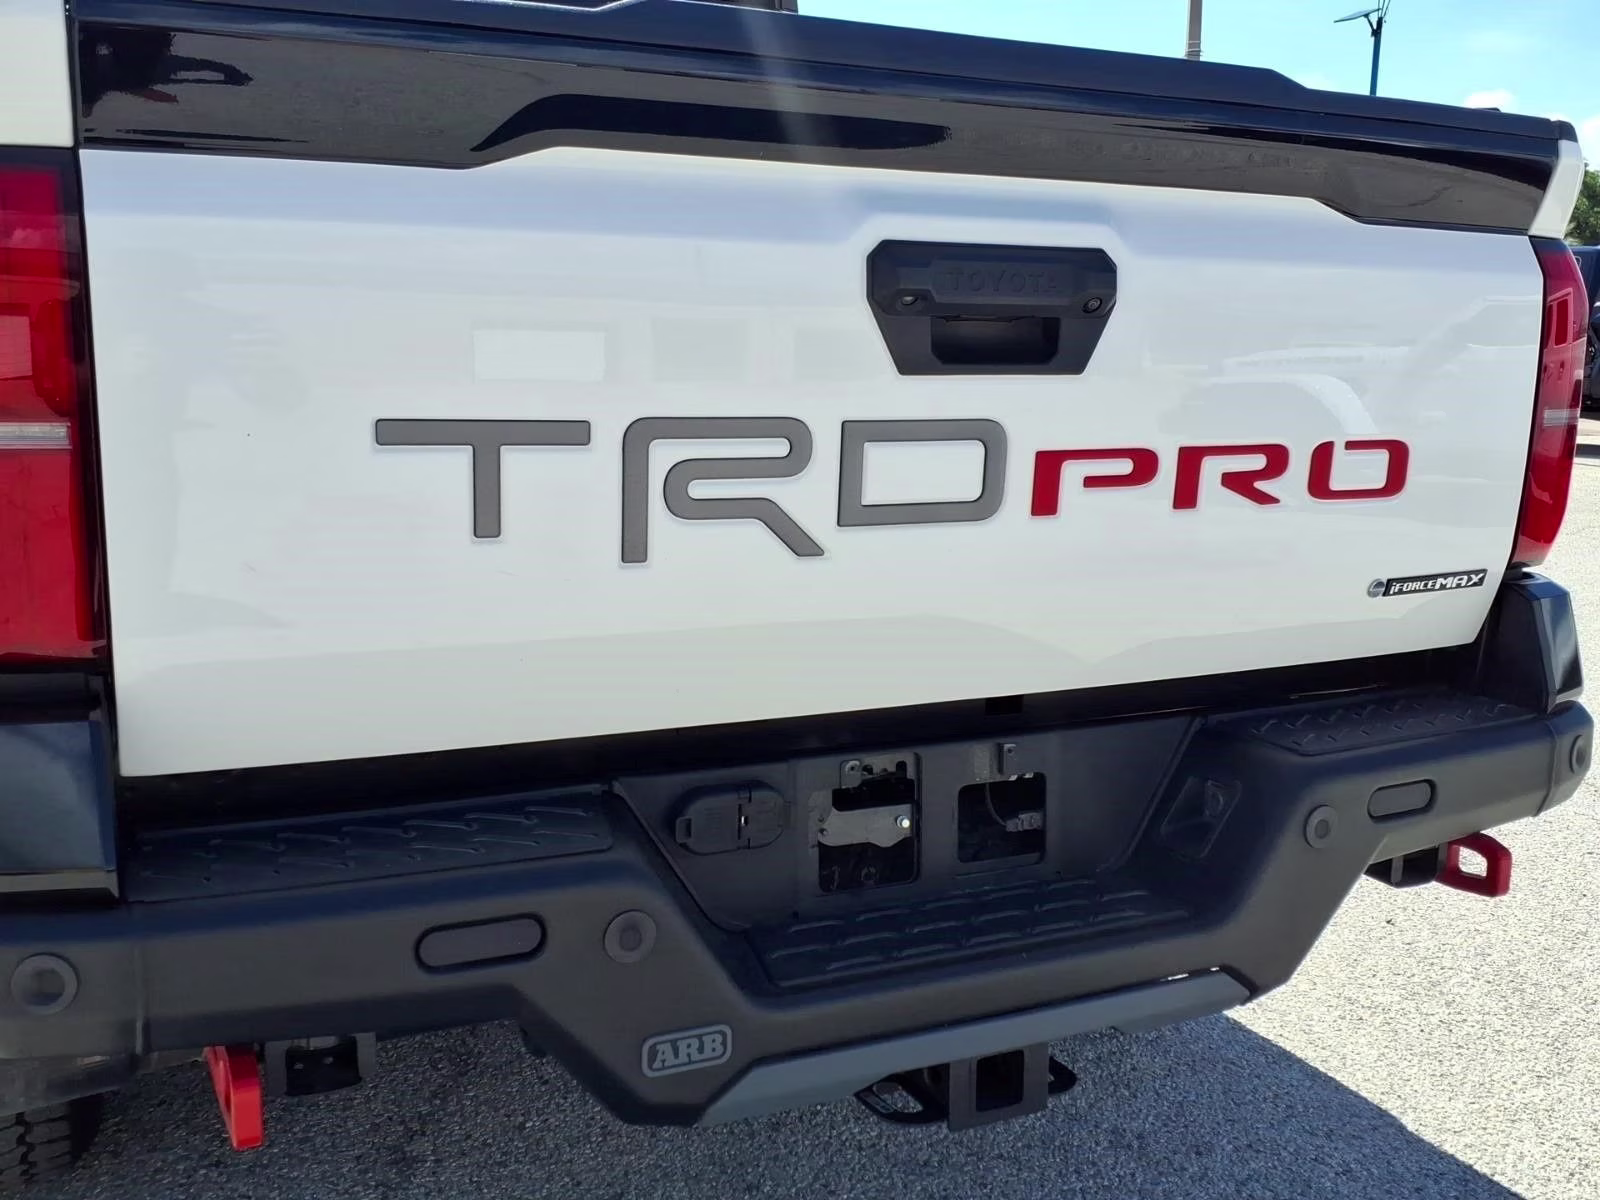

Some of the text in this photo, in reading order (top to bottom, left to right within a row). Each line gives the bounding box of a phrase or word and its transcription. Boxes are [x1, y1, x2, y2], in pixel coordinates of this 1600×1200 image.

[944, 268, 1061, 293] TOYOTA
[375, 416, 1410, 563] TRD PRO
[652, 1033, 724, 1069] ARB
